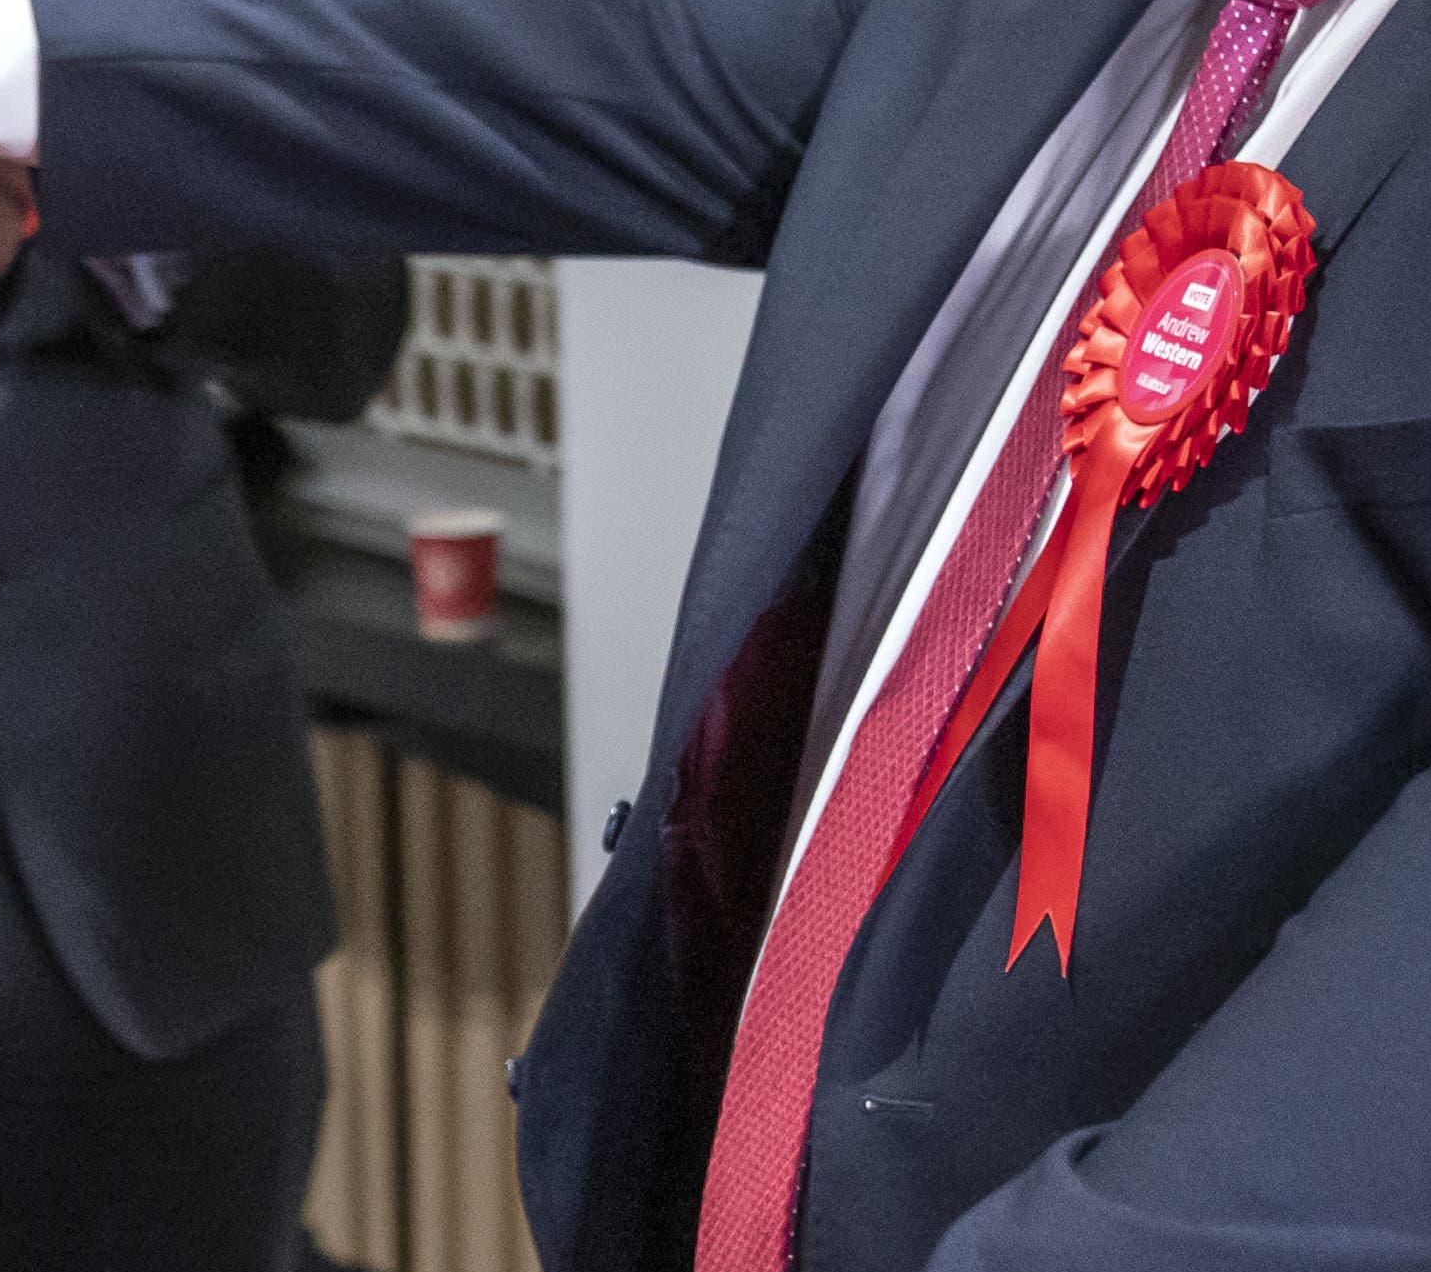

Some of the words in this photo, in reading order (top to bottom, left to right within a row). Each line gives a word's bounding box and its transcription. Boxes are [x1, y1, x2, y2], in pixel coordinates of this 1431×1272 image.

[1189, 290, 1211, 306] VOTE
[1156, 311, 1210, 344] Andrew
[1141, 331, 1203, 370] Western
